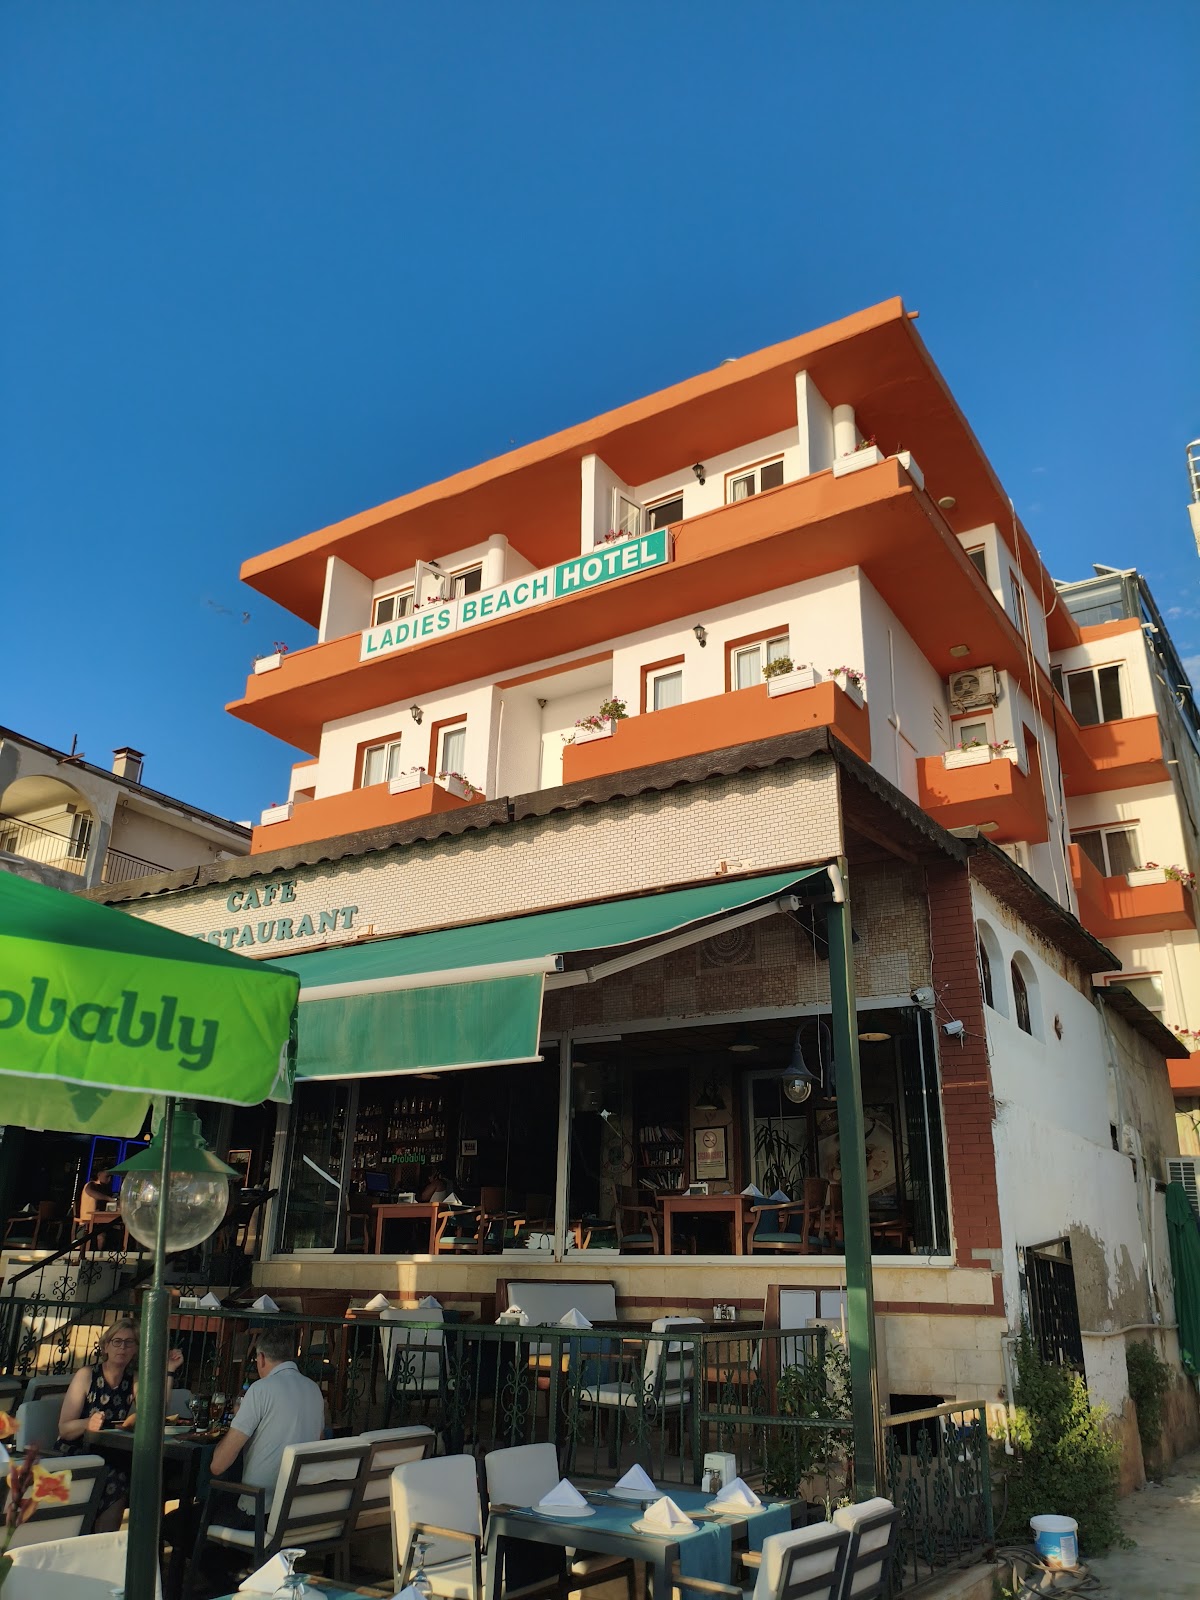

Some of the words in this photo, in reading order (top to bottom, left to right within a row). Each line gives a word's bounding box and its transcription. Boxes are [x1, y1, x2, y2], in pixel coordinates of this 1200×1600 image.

[366, 609, 451, 654] LADIES
[462, 575, 548, 623] BEACH
[562, 540, 658, 590] HOTEL
[226, 880, 297, 913] CAFE
[192, 905, 358, 950] STAURANT
[391, 1152, 426, 1165] Probably
